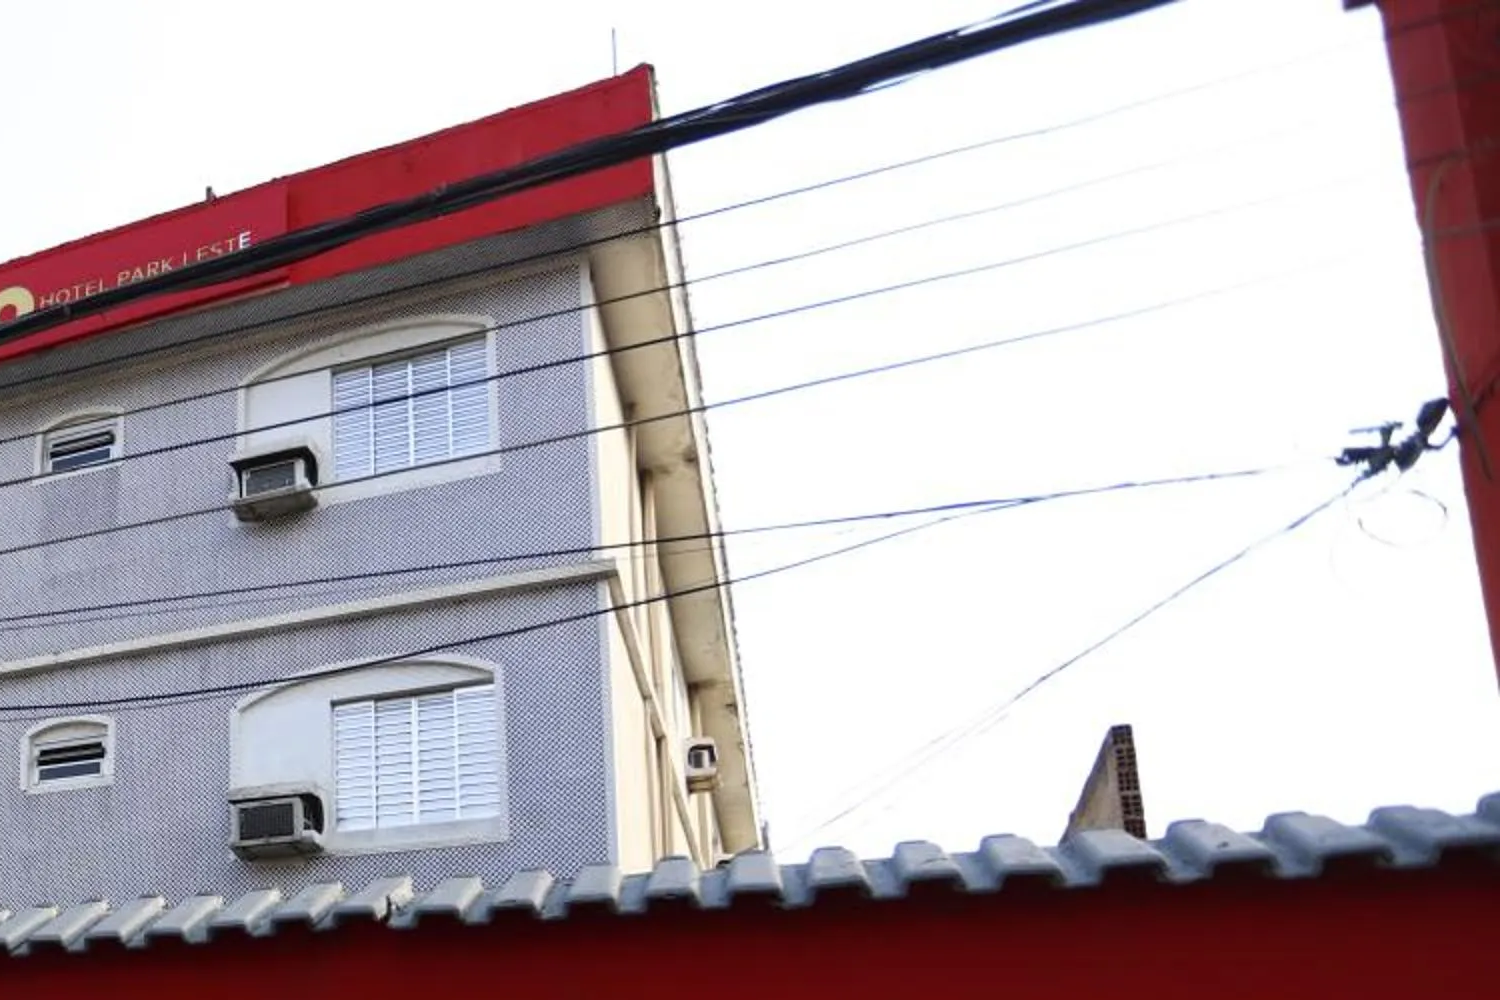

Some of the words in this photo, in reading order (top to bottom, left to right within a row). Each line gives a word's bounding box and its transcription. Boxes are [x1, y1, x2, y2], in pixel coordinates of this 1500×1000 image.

[39, 279, 109, 309] HOTEL
[116, 257, 172, 288] PARK
[181, 231, 251, 268] LESTE
